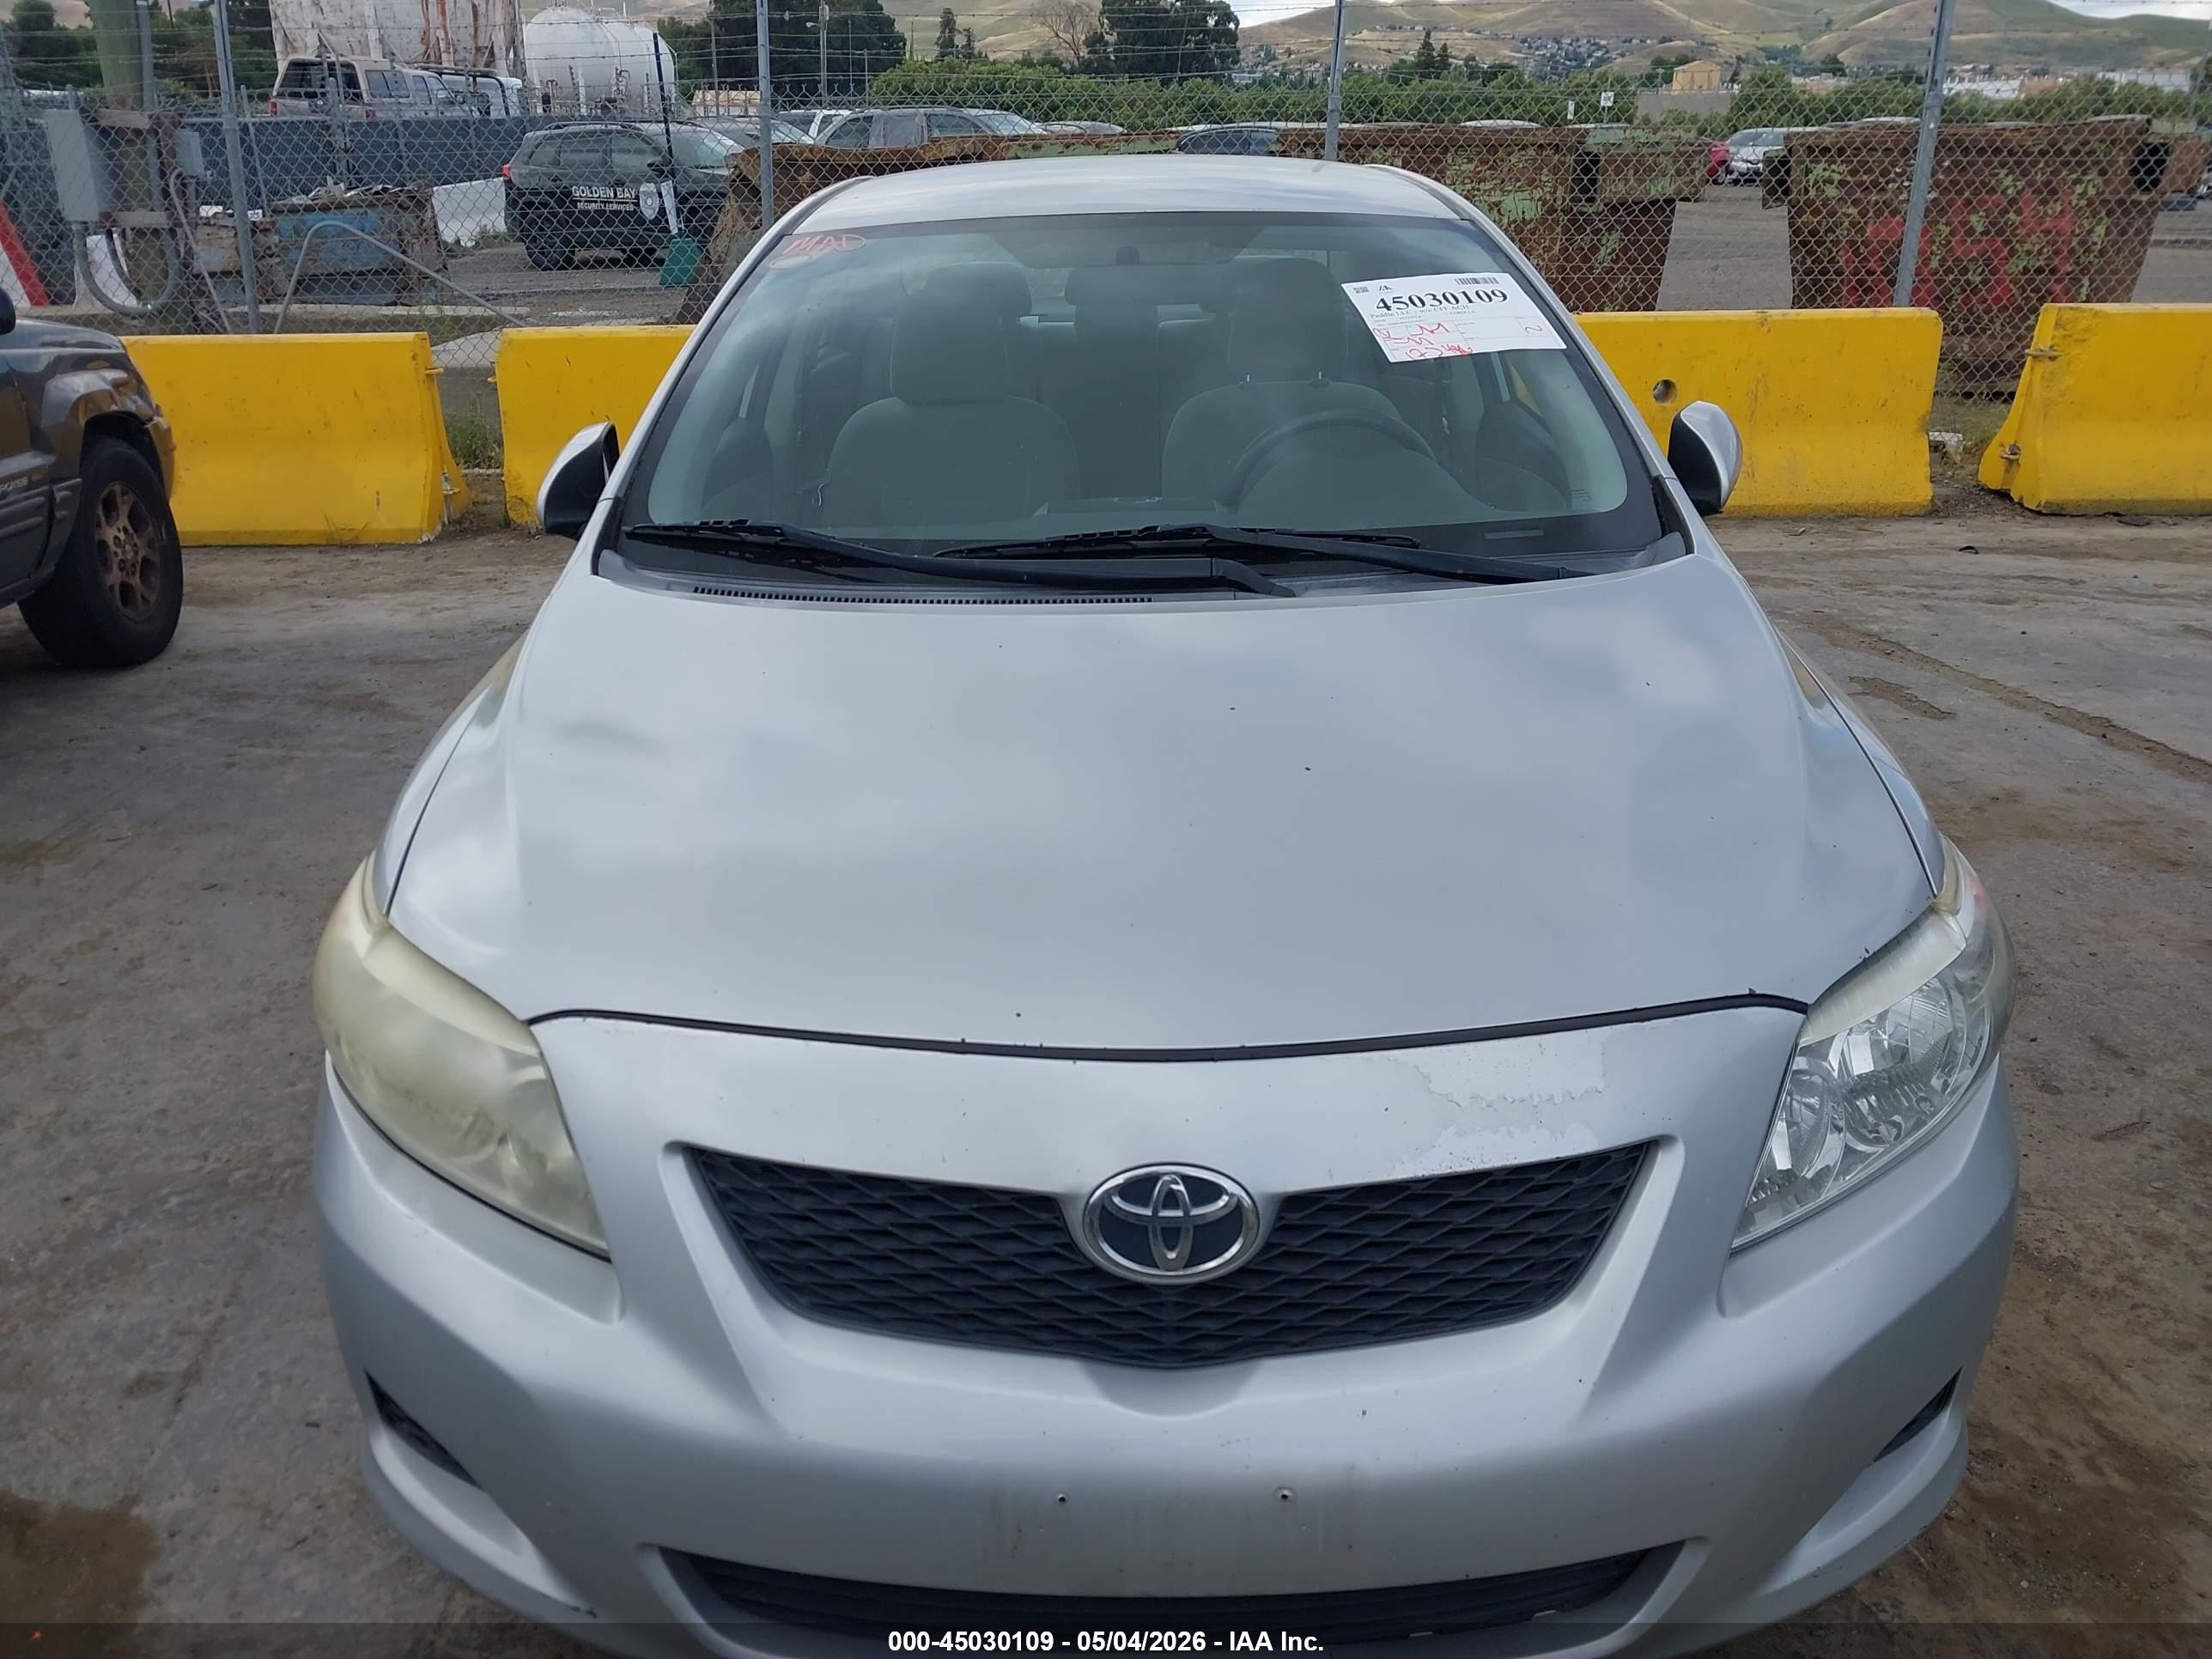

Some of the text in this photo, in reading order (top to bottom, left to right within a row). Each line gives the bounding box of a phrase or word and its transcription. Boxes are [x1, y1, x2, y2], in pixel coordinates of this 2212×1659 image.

[572, 185, 636, 198] GOLDEN BAY
[577, 202, 603, 210] SECURITY
[1376, 289, 1509, 311] 45030109
